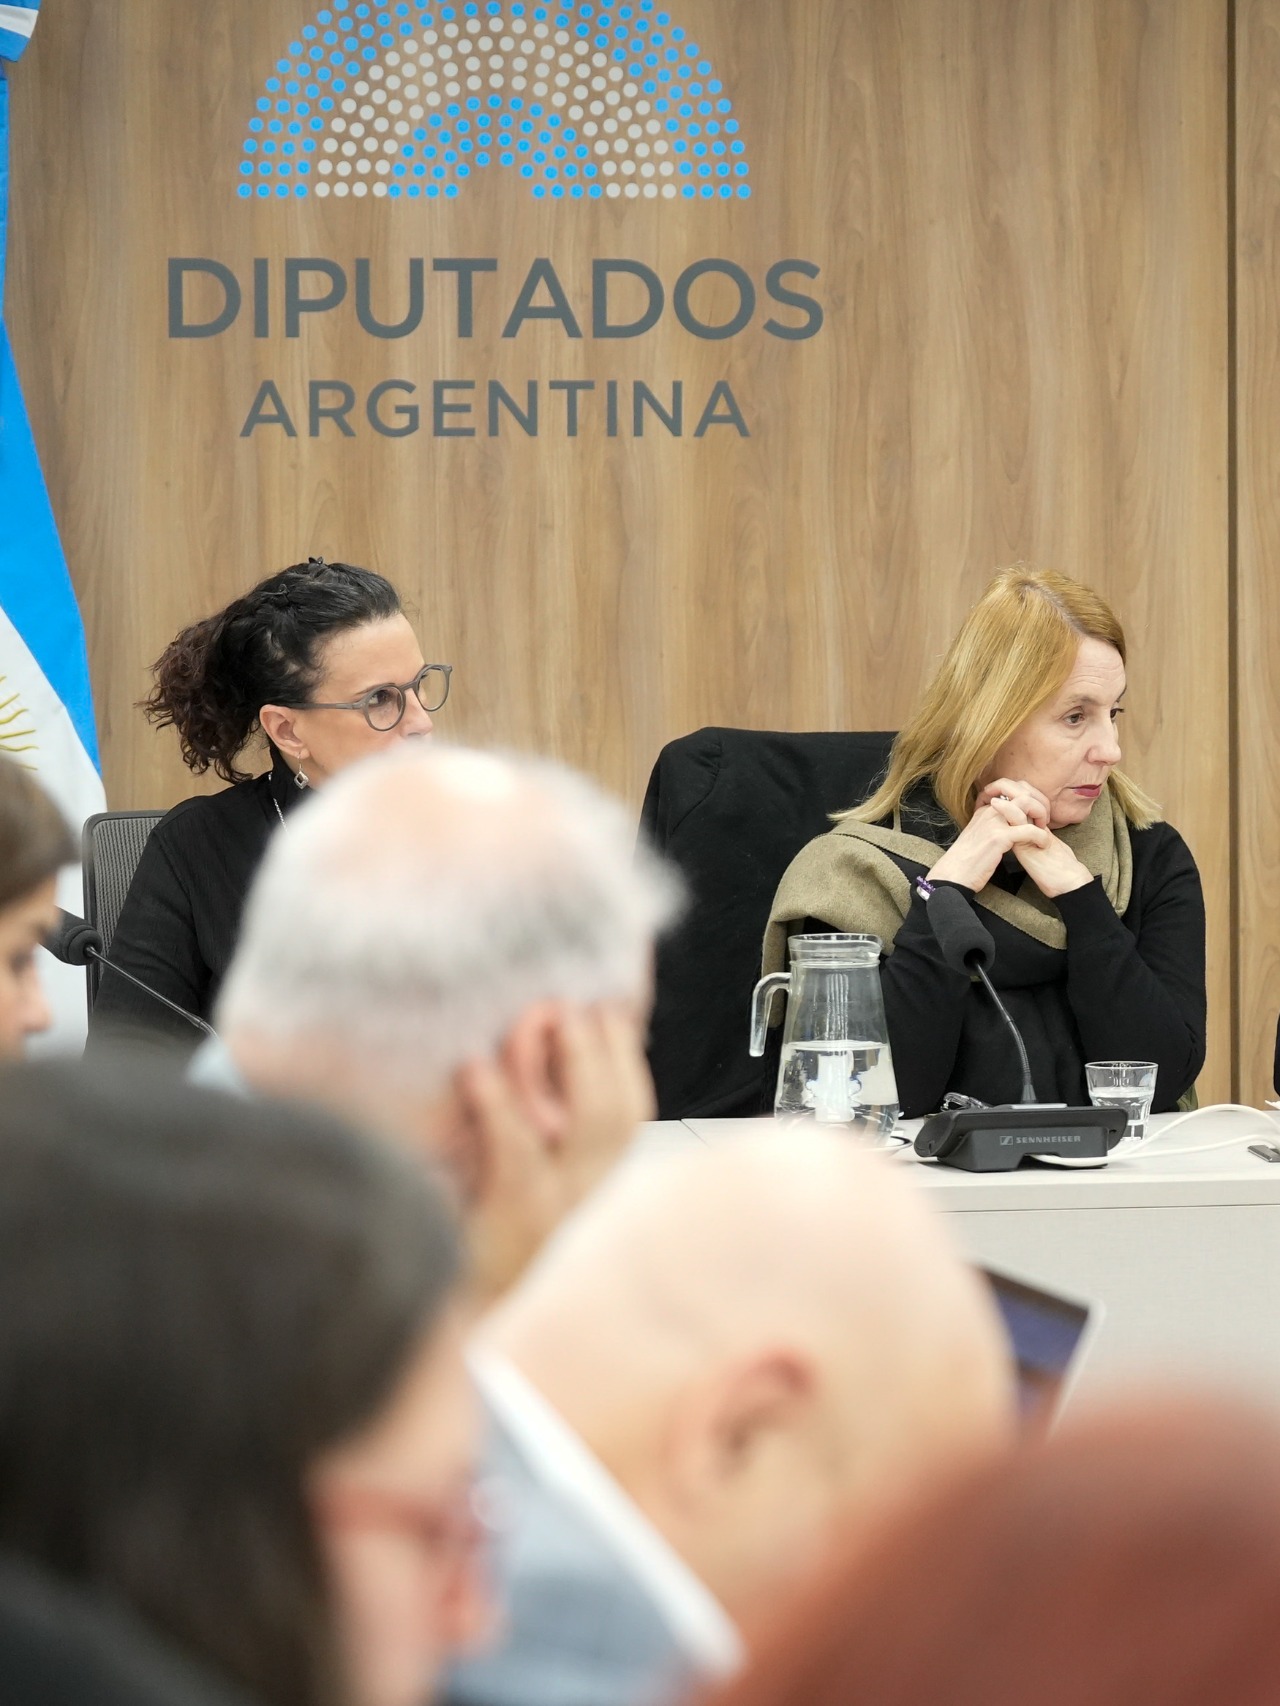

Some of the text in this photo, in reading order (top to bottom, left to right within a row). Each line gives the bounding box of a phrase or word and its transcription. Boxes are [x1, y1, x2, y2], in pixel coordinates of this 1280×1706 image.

[168, 257, 824, 341] DIPUTADOS
[240, 379, 750, 438] ARGENTINA
[1016, 1135, 1081, 1144] SENNHEISER
